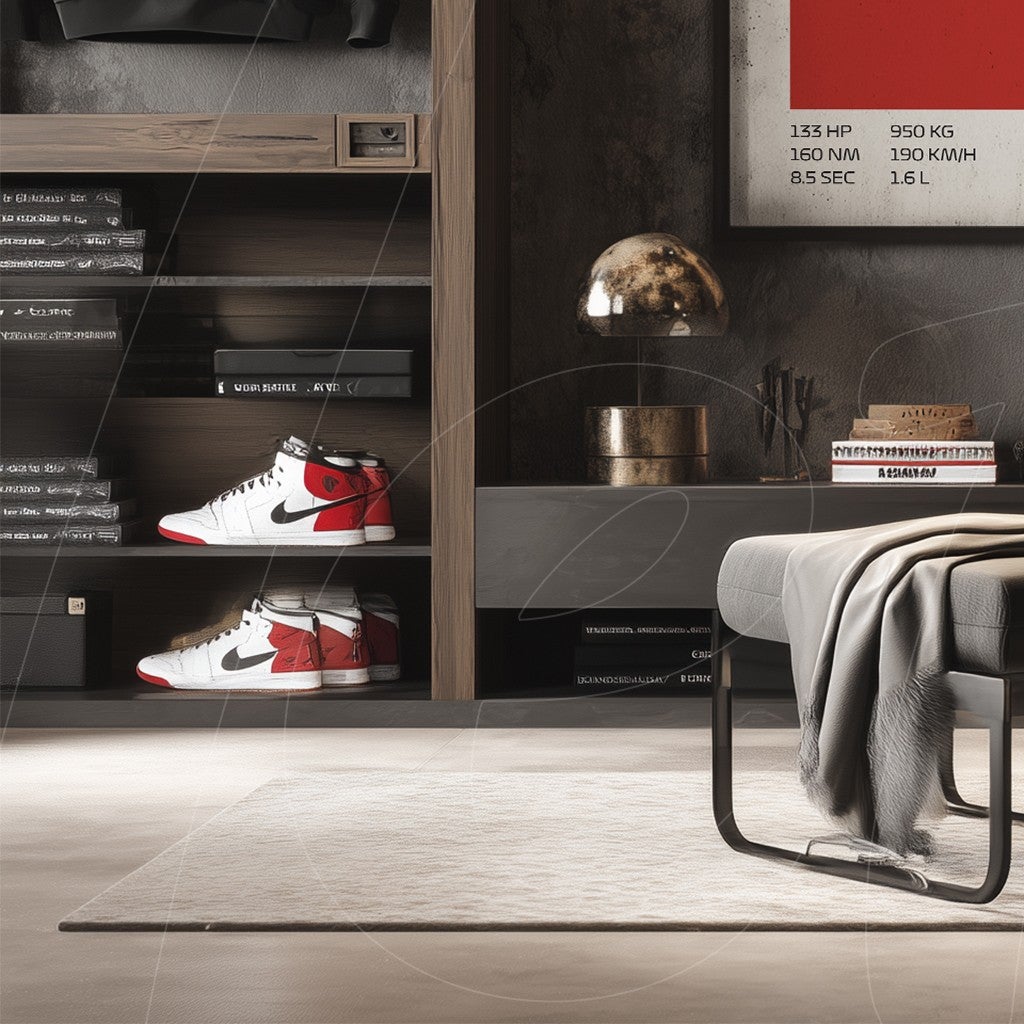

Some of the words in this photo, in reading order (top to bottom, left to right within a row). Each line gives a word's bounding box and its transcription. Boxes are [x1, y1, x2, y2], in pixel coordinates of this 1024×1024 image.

[790, 124, 822, 138] 133
[826, 124, 852, 138] HP
[890, 124, 925, 139] 950
[930, 124, 954, 139] KG
[790, 147, 823, 162] 160
[828, 147, 860, 162] NM
[890, 147, 924, 162] 190
[928, 147, 976, 163] KM/H
[790, 170, 816, 185] 8.5
[820, 170, 856, 185] SEC
[890, 170, 916, 185] 1.6
[920, 170, 930, 185] L
